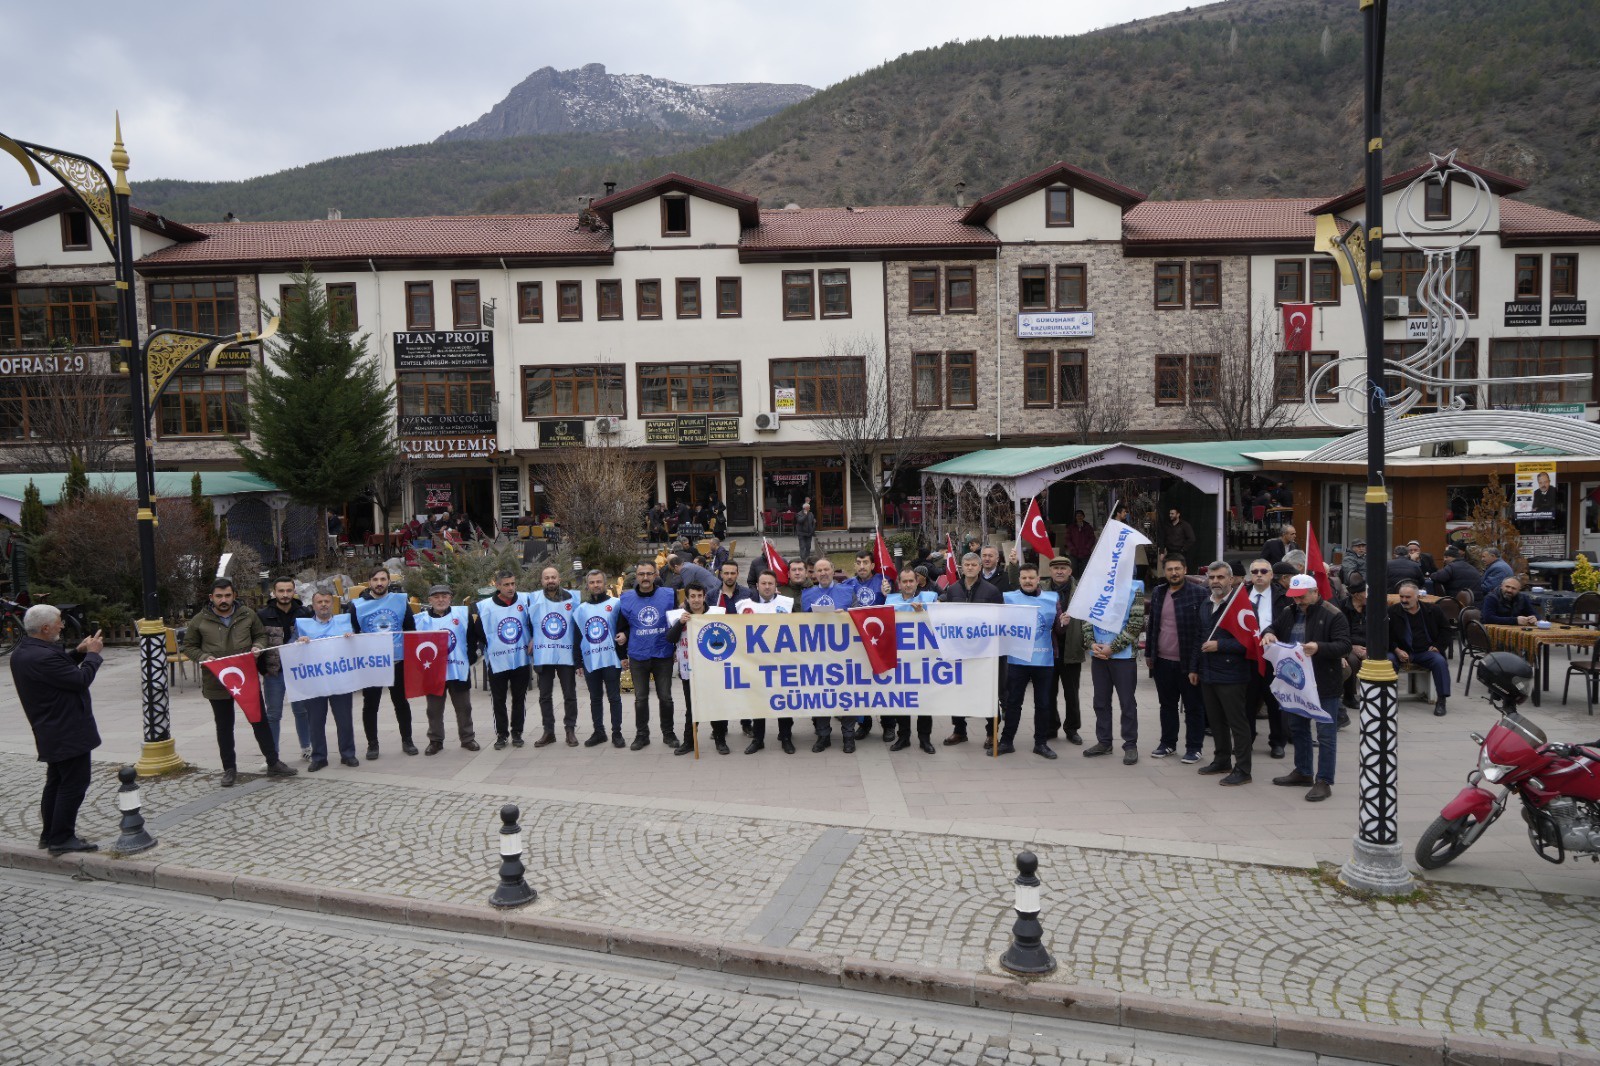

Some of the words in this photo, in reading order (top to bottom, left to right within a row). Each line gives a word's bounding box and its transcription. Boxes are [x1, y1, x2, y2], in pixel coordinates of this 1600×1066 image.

[1507, 304, 1541, 313] AVUKAT
[1551, 303, 1586, 312] AVUKAT
[63, 355, 84, 373] 29
[400, 435, 497, 454] KURUYEMİŞ
[1089, 593, 1113, 622] TÜRK
[1103, 527, 1134, 593] SAĞLIK-SEN
[745, 622, 940, 654] KAMU-EN
[934, 623, 963, 639] TÜRK
[966, 622, 1032, 640] SAĞLIK-SEN
[290, 662, 324, 681] TÜRK
[325, 654, 392, 676] SAĞLIK-SEN
[724, 662, 751, 690] İL
[769, 690, 919, 712] GÜMÜŞHANE
